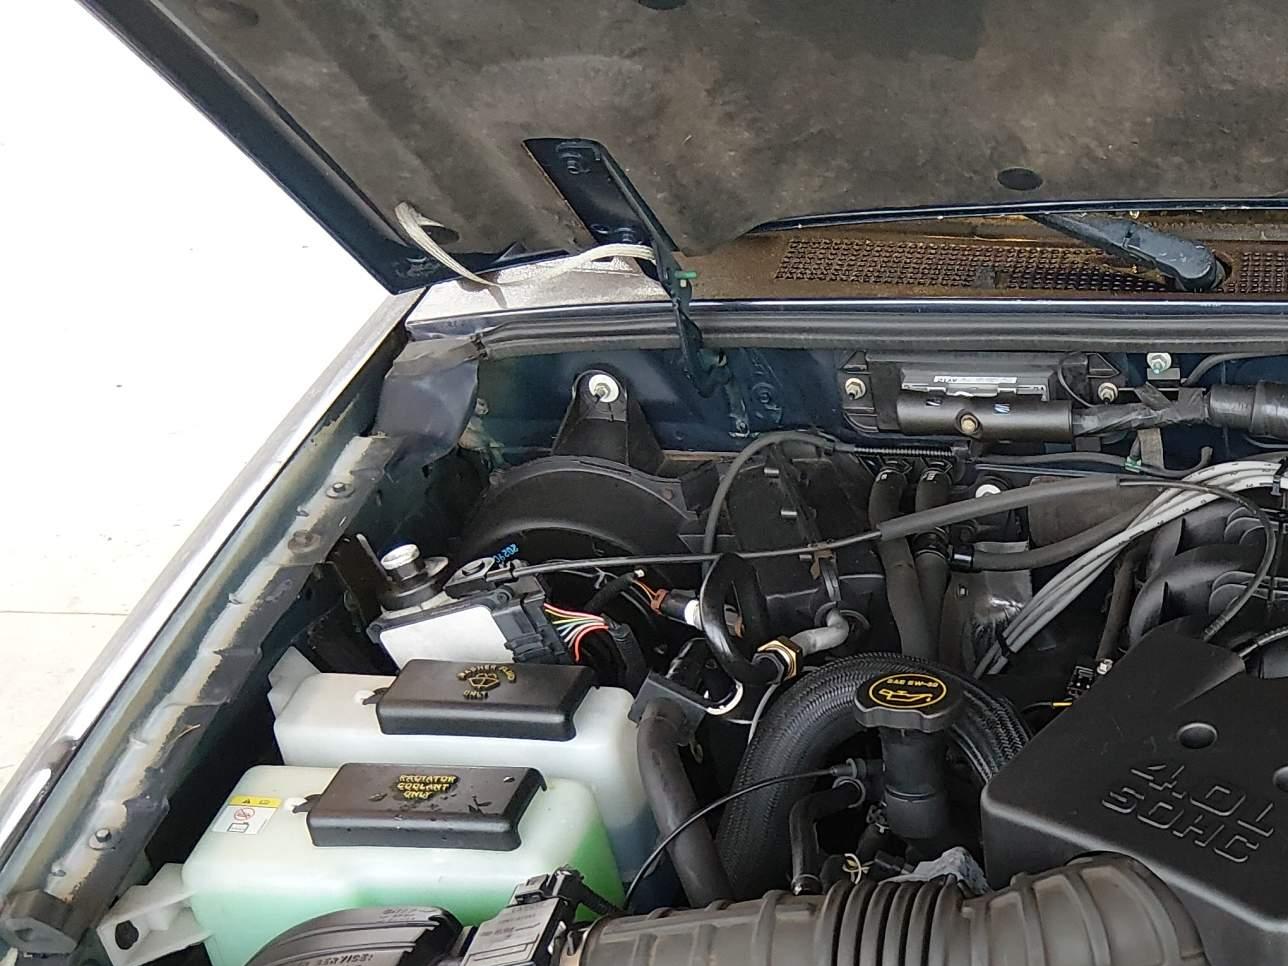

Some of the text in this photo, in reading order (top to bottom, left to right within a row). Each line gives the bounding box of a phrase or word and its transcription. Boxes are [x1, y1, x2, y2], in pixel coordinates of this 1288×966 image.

[464, 690, 488, 699] ONLY
[400, 775, 457, 783] RADIATOR
[397, 783, 450, 791] COOLANT
[403, 791, 433, 799] ONLY
[1131, 764, 1274, 836] 4.0L
[1102, 787, 1260, 863] SOHC
